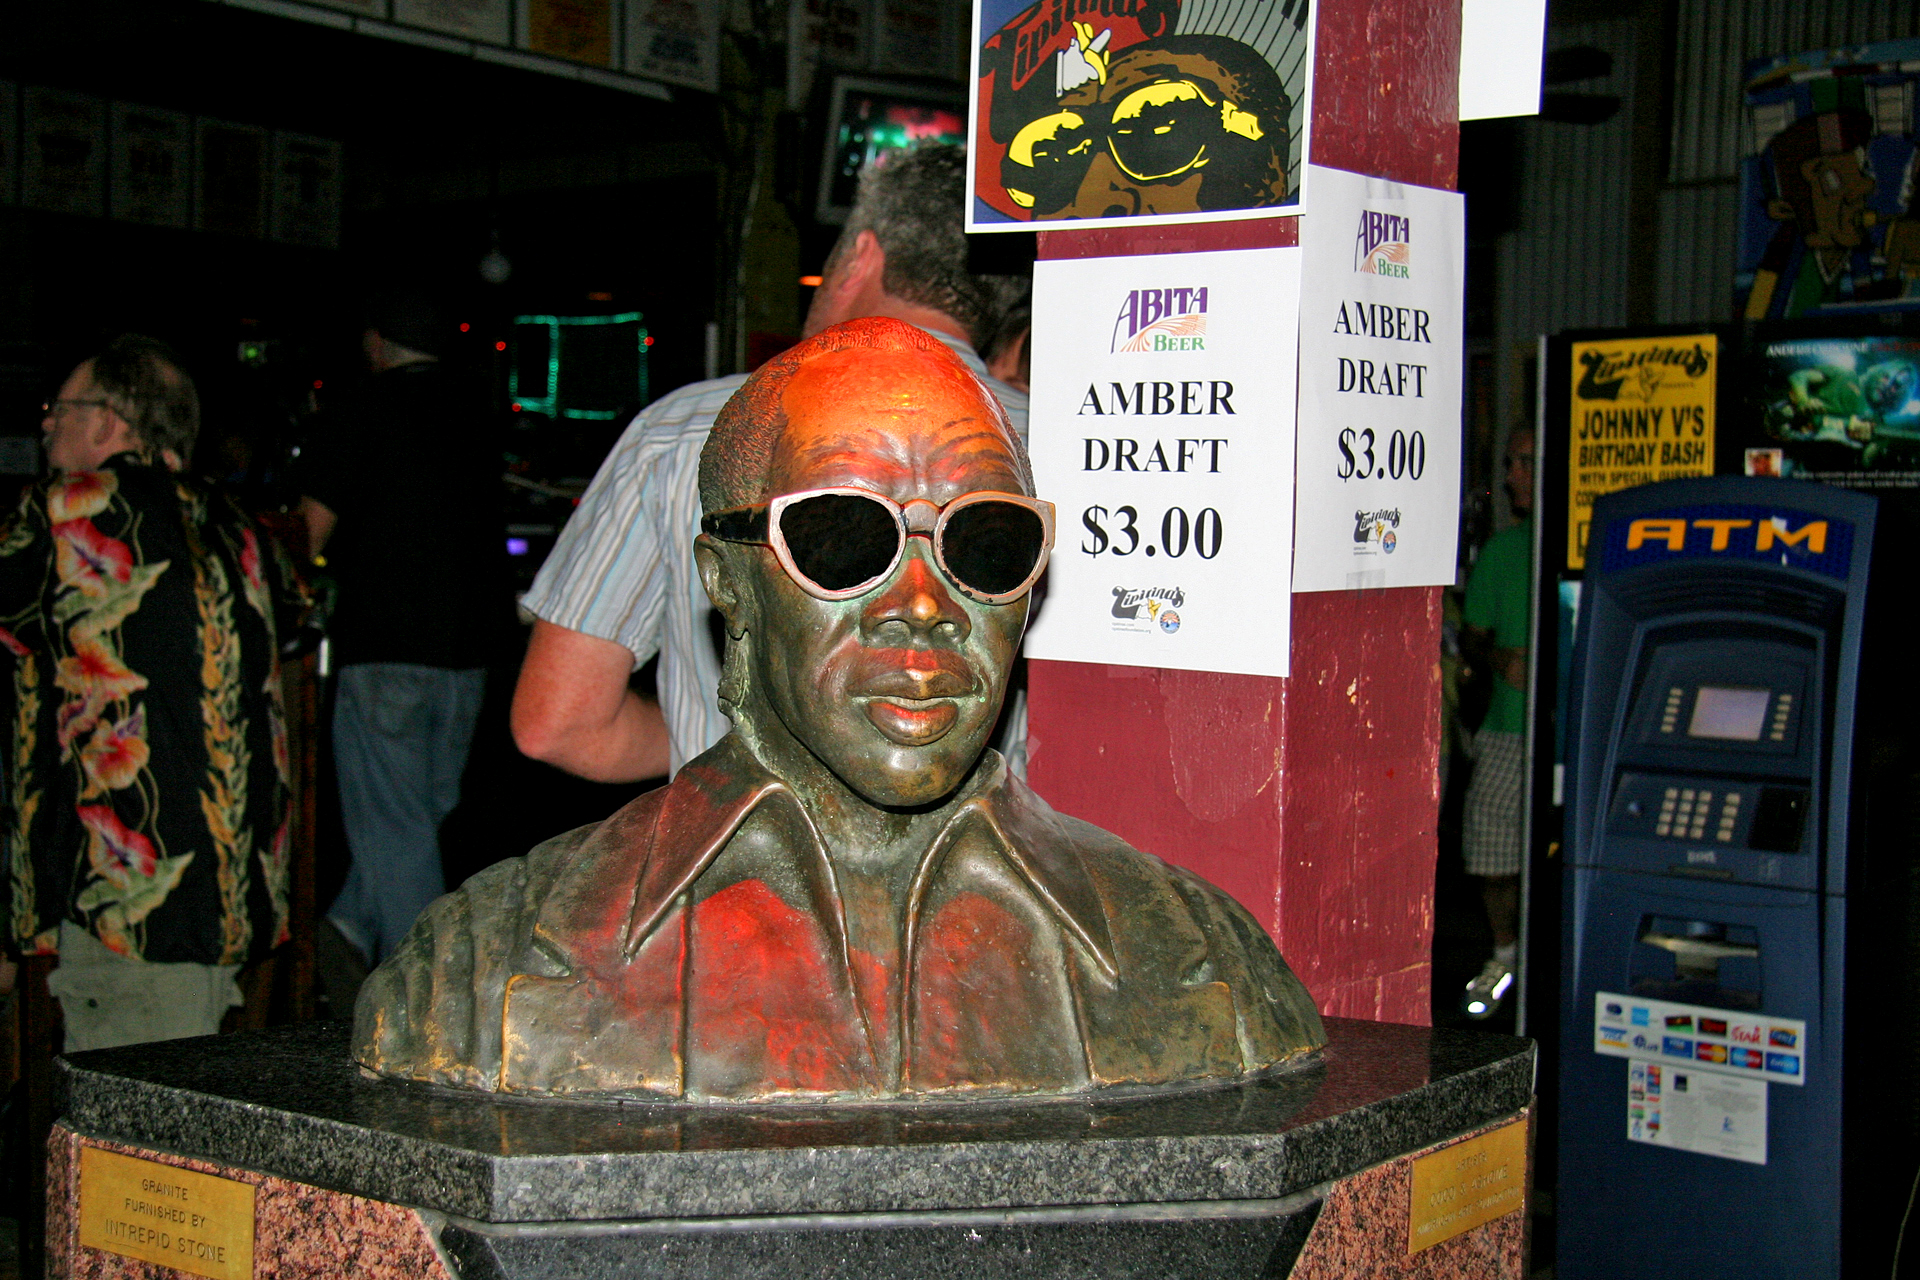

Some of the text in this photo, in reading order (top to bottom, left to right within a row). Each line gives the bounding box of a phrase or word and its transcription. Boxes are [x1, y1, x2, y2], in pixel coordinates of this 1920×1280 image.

[1354, 209, 1410, 273] ABITA
[1110, 286, 1208, 354] ABITA
[1333, 300, 1431, 343] AMBER
[1337, 357, 1427, 398] DRAFT
[1077, 380, 1237, 416] AMBER
[1579, 405, 1704, 440] JOHNNY V'S
[1081, 438, 1229, 474] DRAFT
[1337, 427, 1426, 483] $3.00
[1579, 441, 1705, 467] BIRTHDAY BASH
[1579, 472, 1606, 485] WITH
[1081, 504, 1223, 560] $3.00
[1626, 518, 1829, 554] ATM
[142, 1178, 188, 1201] GRANITE
[1430, 1186, 1456, 1208] COCO
[1460, 1182, 1466, 1196] &
[124, 1198, 206, 1229] FURNISHED BY
[105, 1219, 226, 1264] INTREPID STONE
